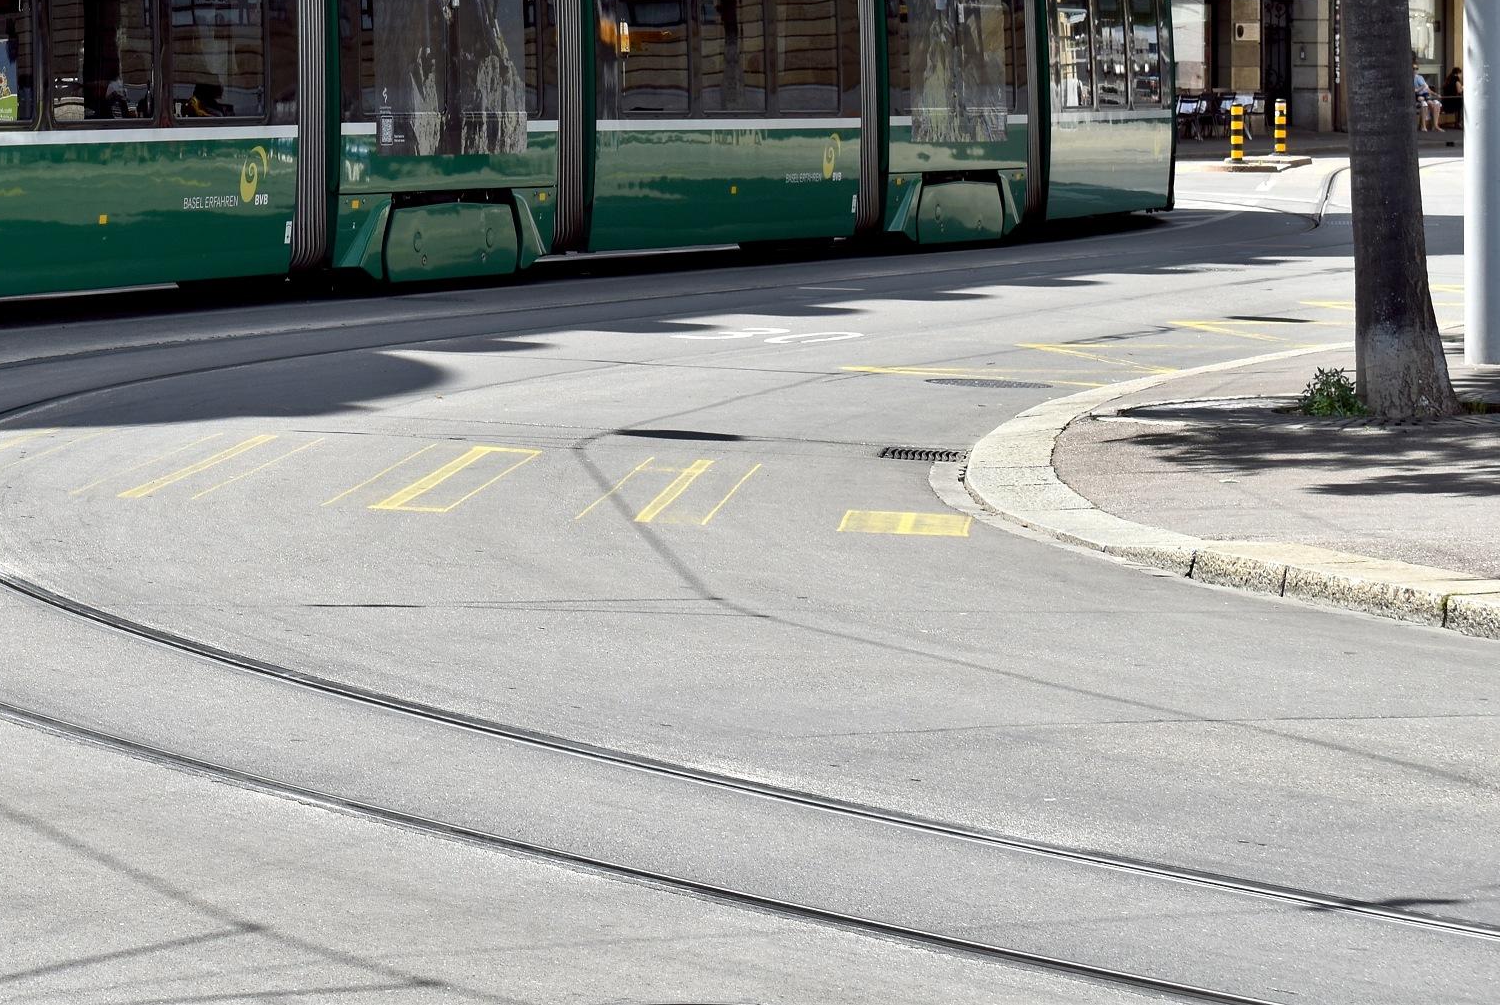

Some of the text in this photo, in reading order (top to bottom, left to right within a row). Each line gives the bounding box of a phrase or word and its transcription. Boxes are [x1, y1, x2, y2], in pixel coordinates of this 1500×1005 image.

[183, 194, 269, 210] BASEL ERFAHREN BVB
